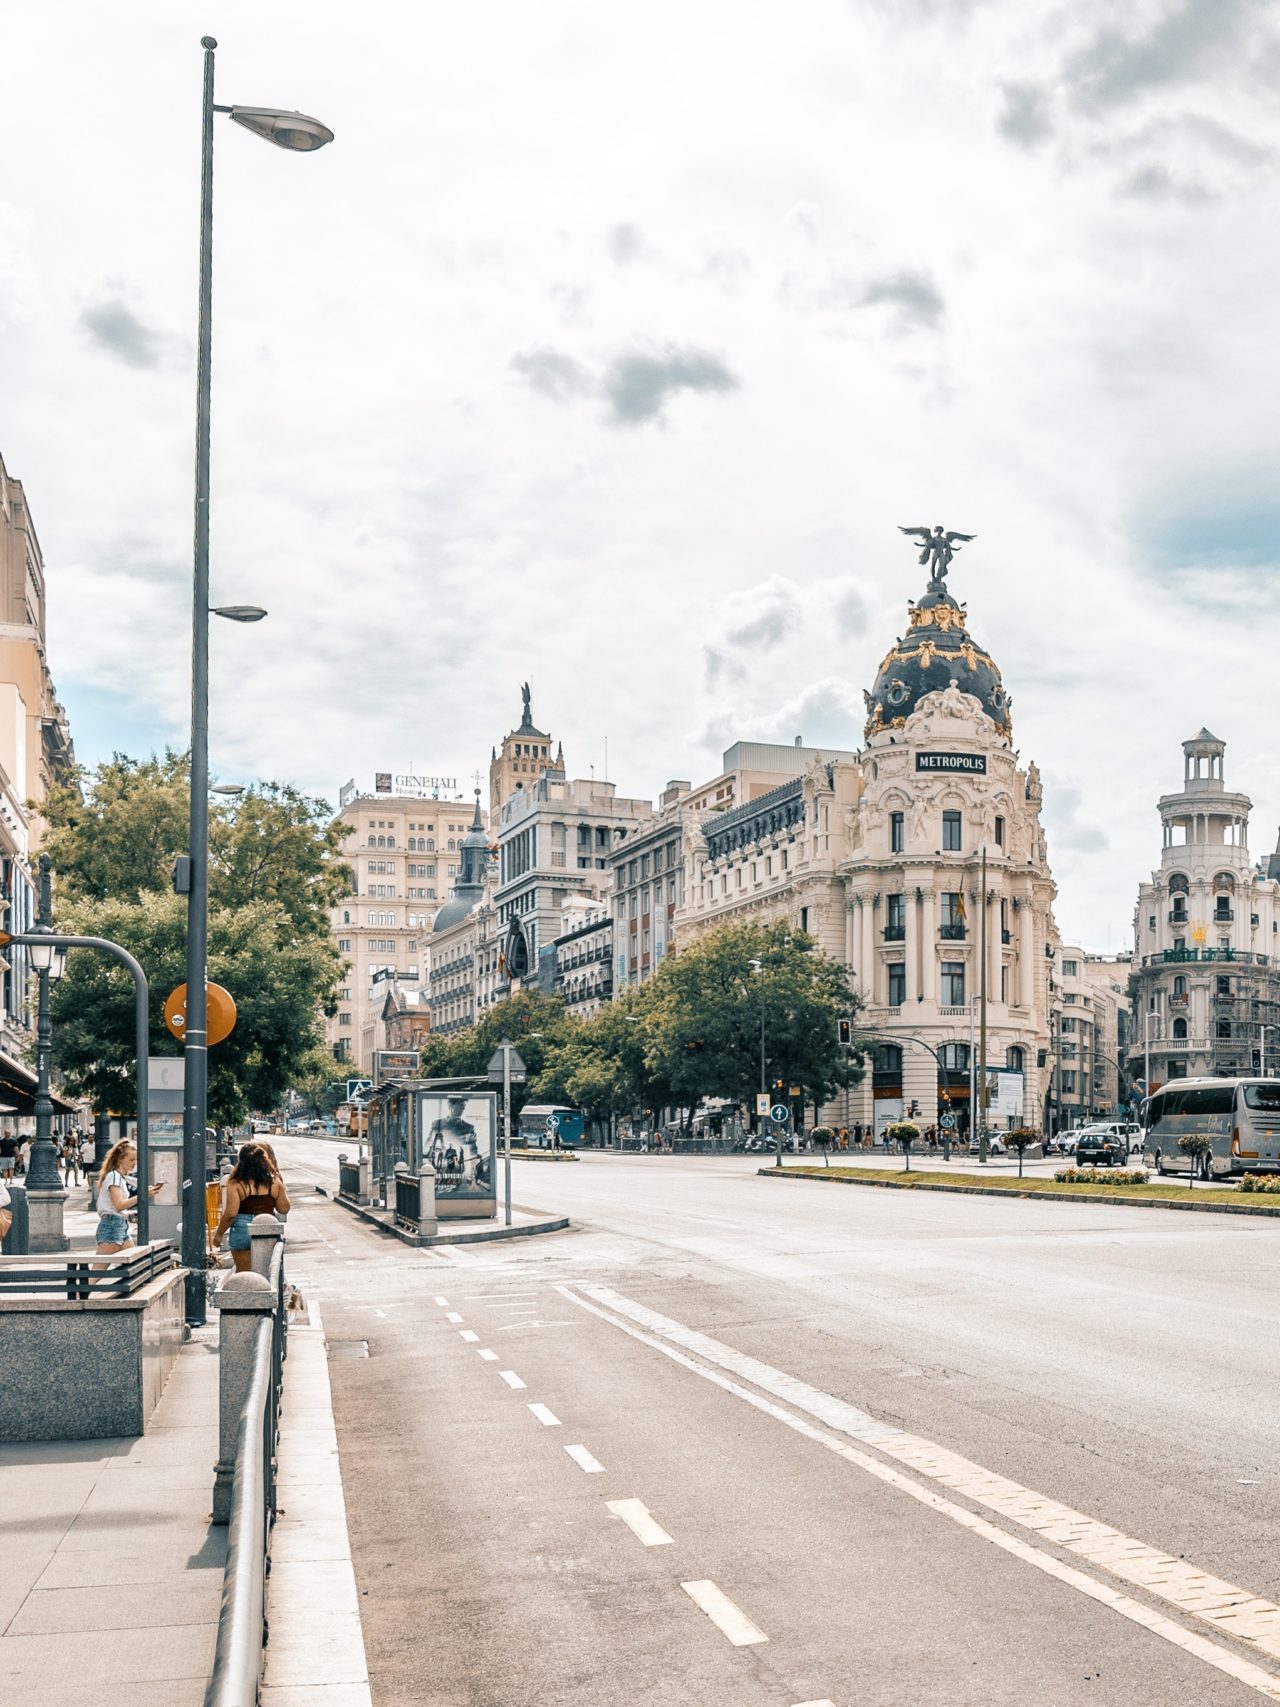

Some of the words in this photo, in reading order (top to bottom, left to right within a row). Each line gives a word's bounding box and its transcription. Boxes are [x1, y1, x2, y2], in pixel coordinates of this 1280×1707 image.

[919, 756, 984, 770] METROPOLIS
[395, 774, 457, 789] GENERALI
[1163, 946, 1237, 962] ROLEX
